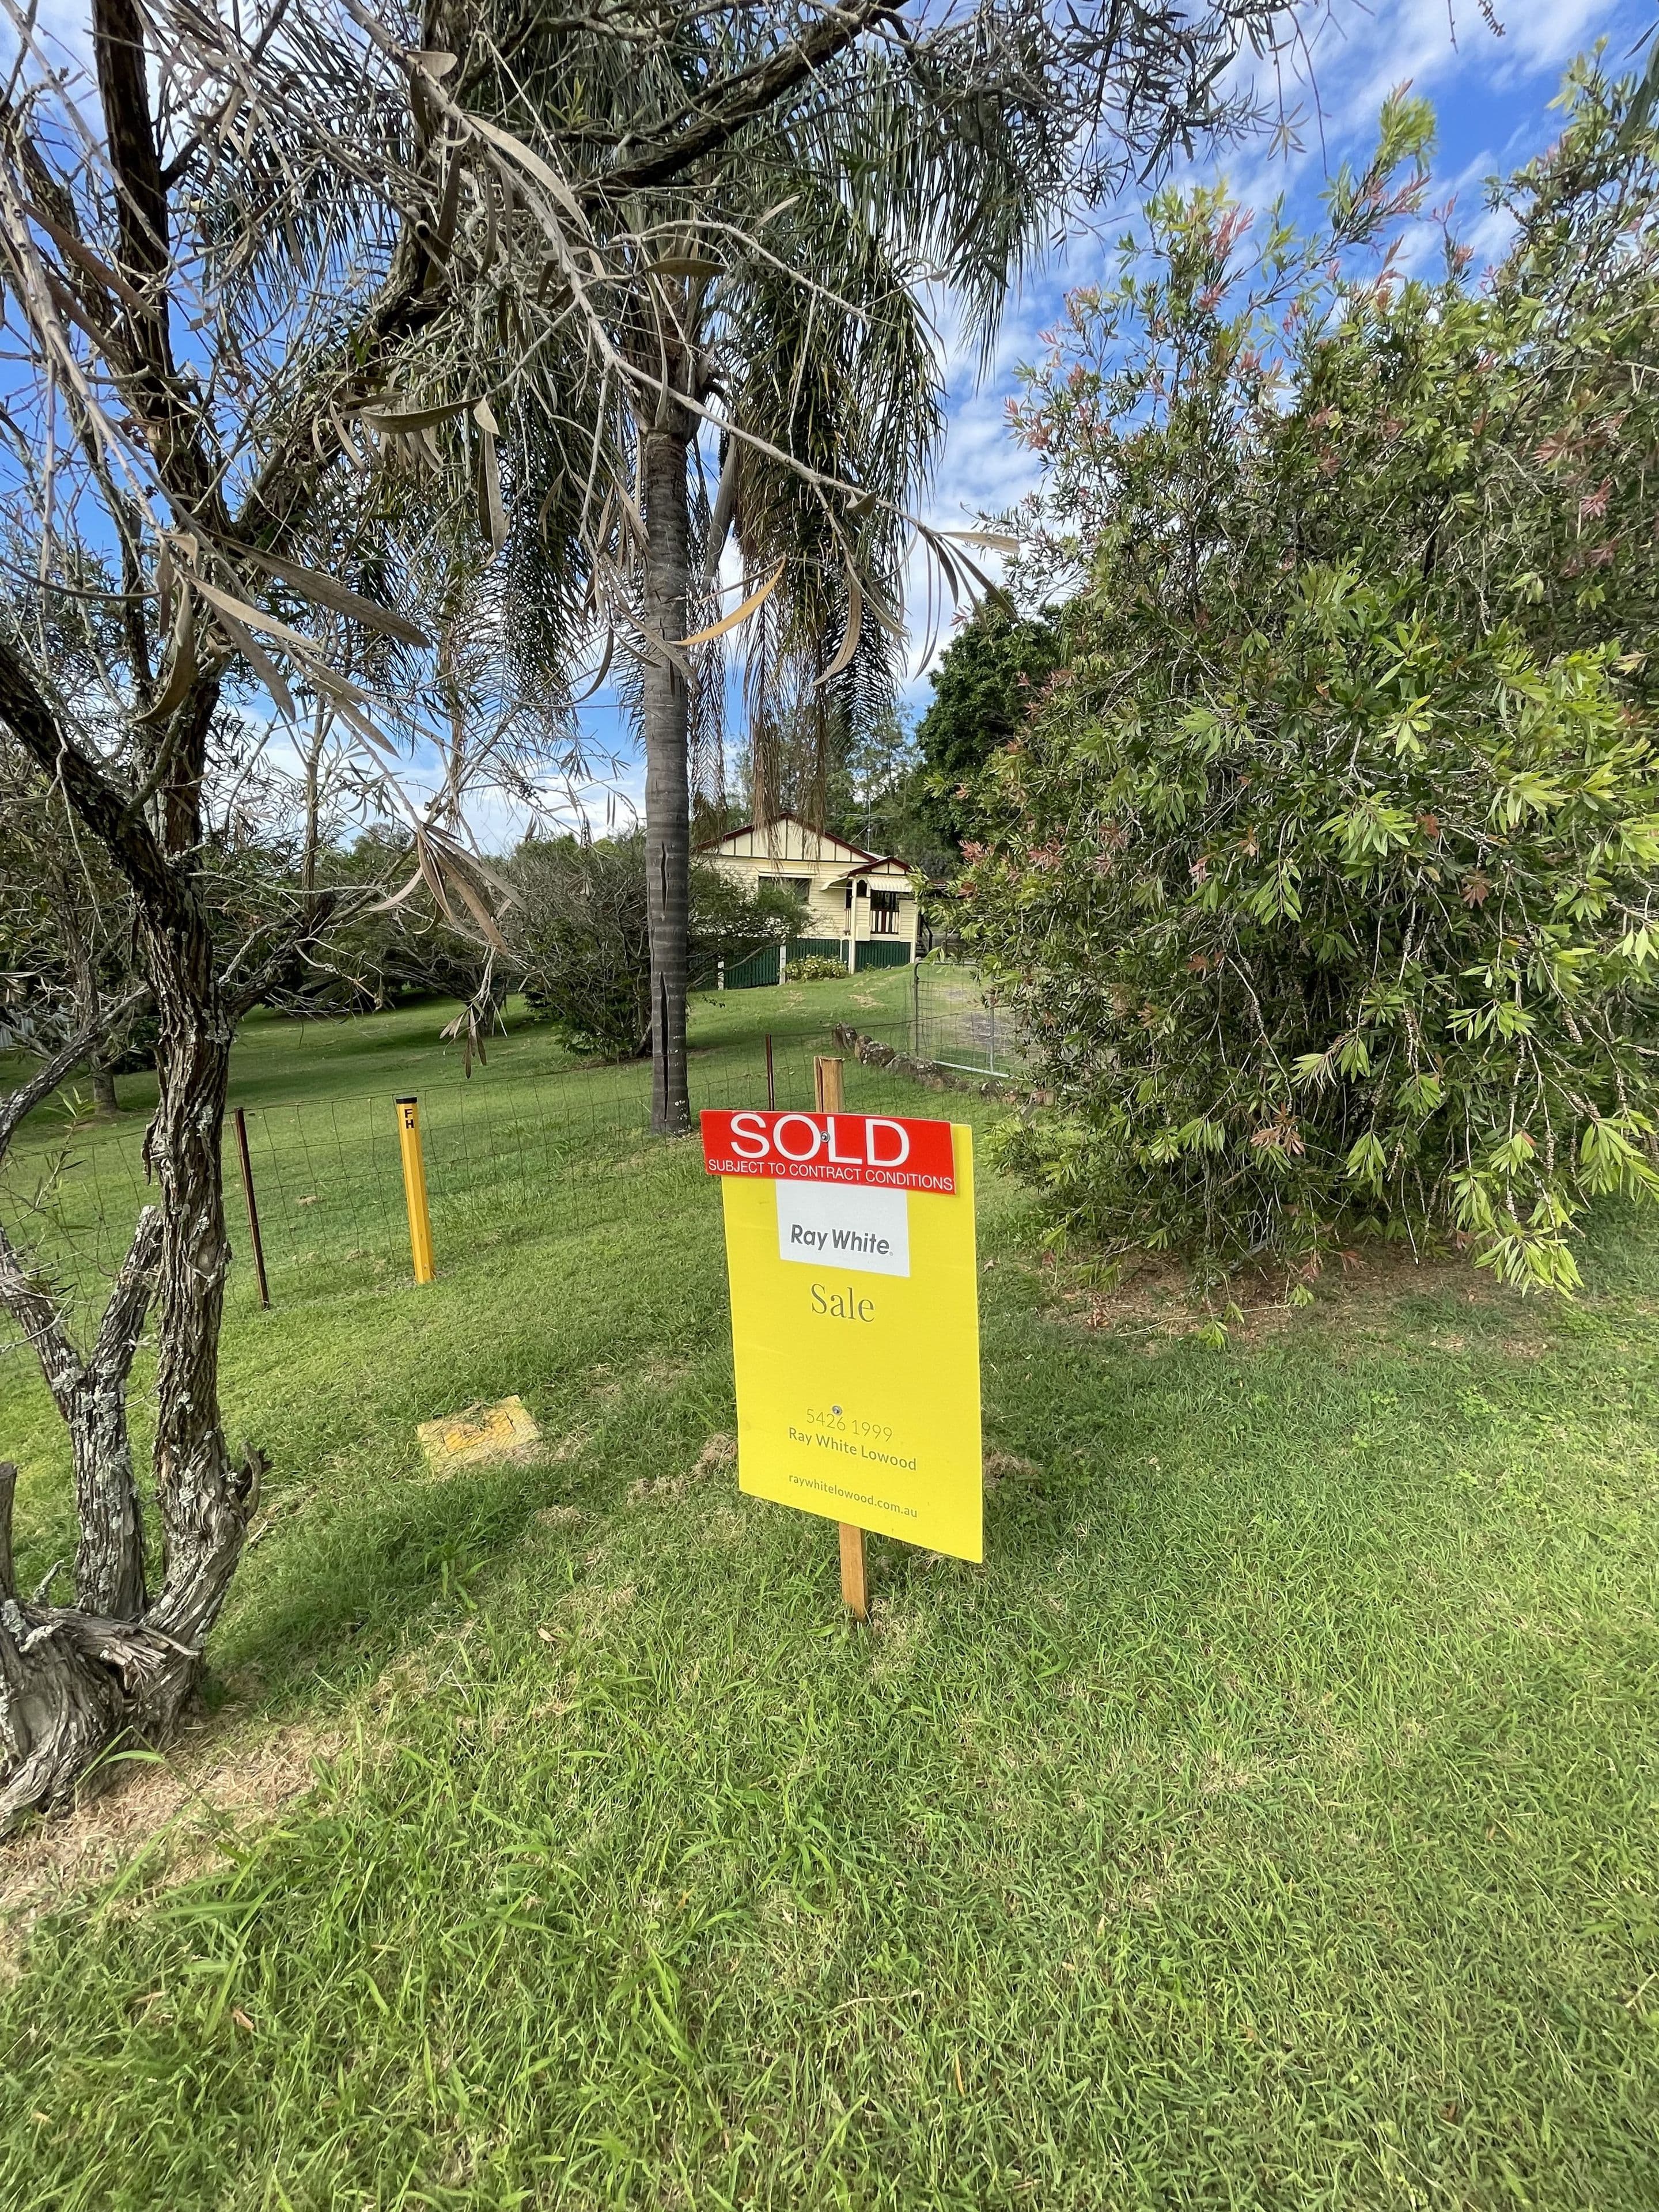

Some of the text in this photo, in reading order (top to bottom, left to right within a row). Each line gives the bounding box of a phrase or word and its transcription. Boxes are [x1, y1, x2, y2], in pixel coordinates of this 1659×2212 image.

[730, 1113, 910, 1167] SOLD
[709, 1160, 953, 1191] SUBJECT TO CONTRACT CONDITIONS
[791, 1224, 890, 1255] Ray White
[811, 1283, 874, 1322] Sale
[806, 1408, 892, 1442] 5426 1999
[789, 1427, 916, 1471] Ray White Lowood
[789, 1474, 917, 1518] raywhitelowood.com.au
